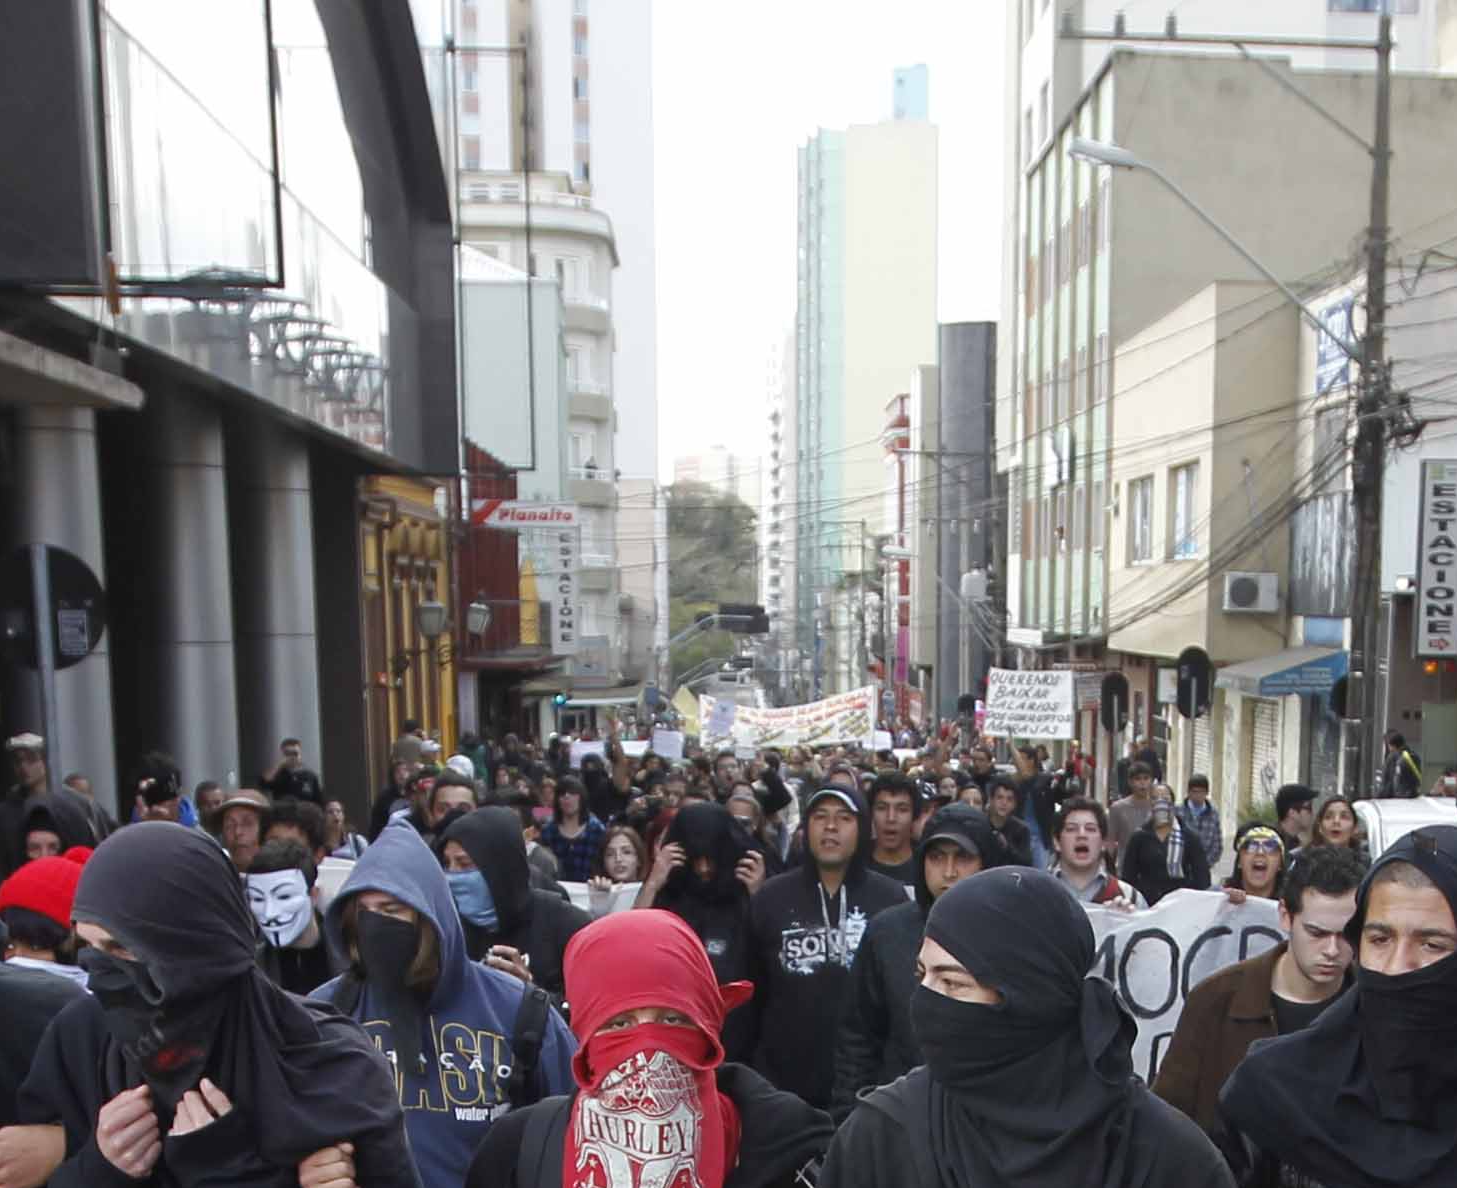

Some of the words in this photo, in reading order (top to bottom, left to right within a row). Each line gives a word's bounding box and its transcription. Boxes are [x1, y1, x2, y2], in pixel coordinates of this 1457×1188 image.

[498, 507, 573, 523] Planalto
[1425, 482, 1457, 635] ESTACIONE
[558, 532, 574, 643] ESTACIONE
[989, 671, 1062, 686] QUEREMOS
[993, 684, 1050, 699] BAIXAR
[454, 1105, 489, 1121] water
[588, 1107, 689, 1156] HURLEY
